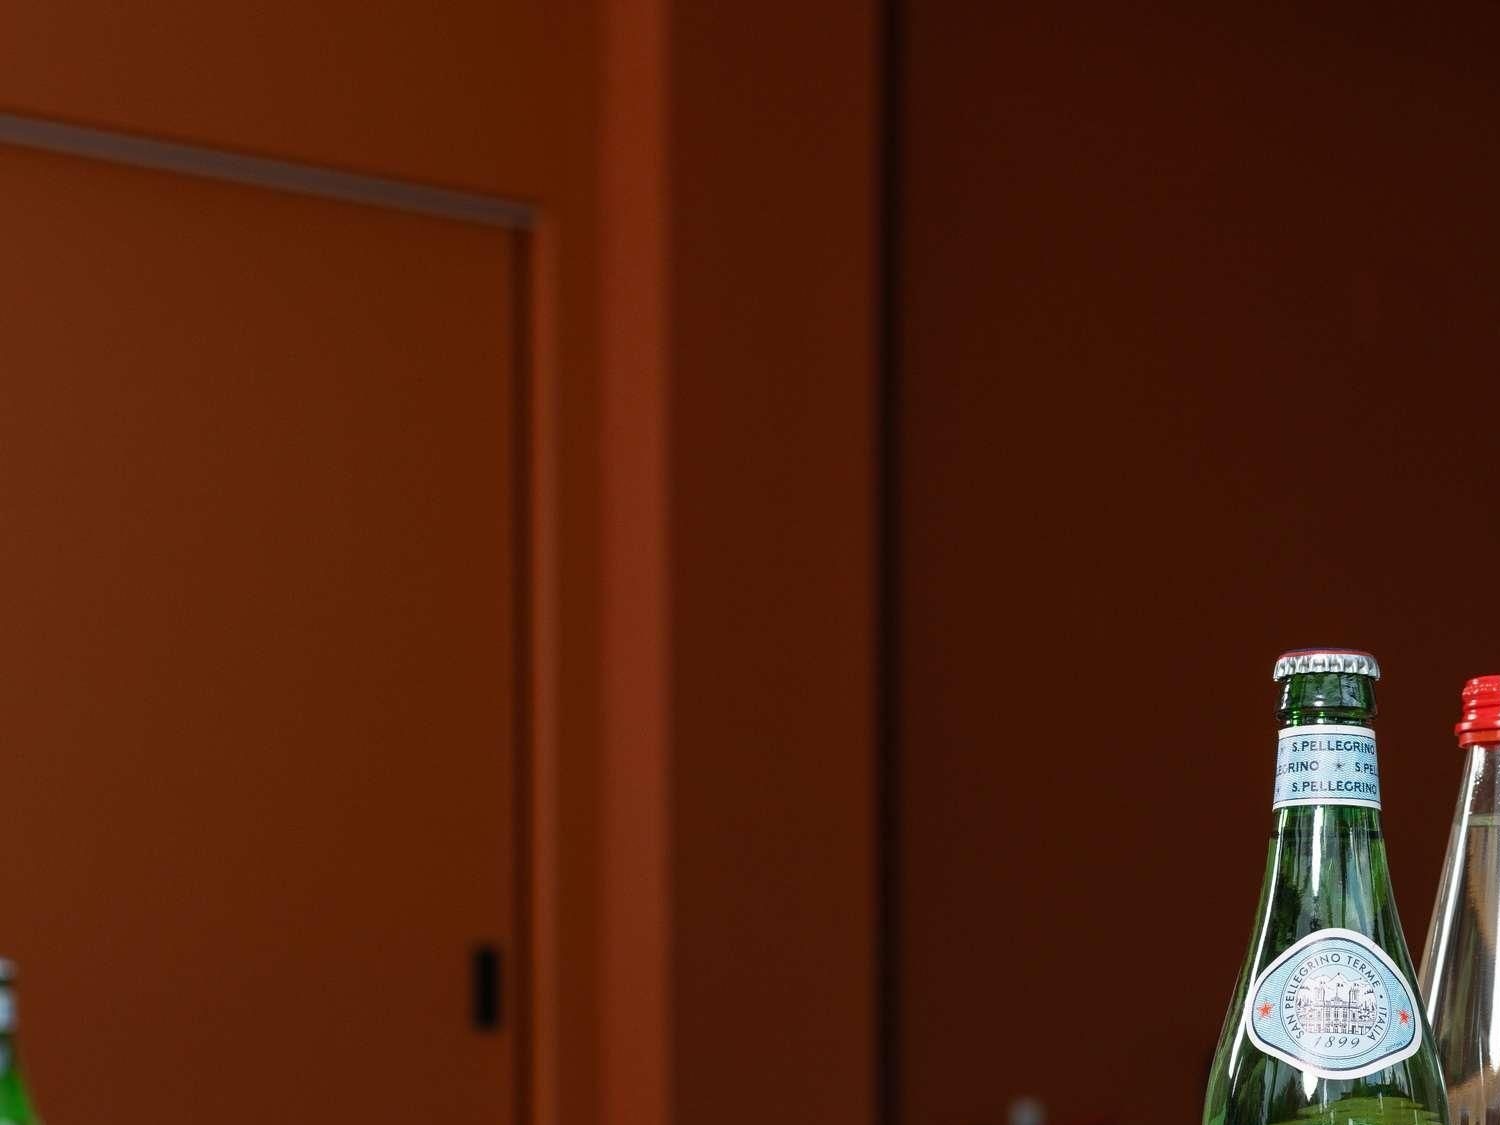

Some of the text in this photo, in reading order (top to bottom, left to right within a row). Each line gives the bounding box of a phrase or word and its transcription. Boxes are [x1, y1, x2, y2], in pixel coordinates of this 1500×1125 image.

[1292, 740, 1375, 755] S.PELLEGRINO
[1291, 780, 1377, 795] S.PELLEGRINO
[1285, 953, 1387, 1042] SAN PELLEGRINO TERME ITALIA
[1313, 1035, 1361, 1049] 1899
